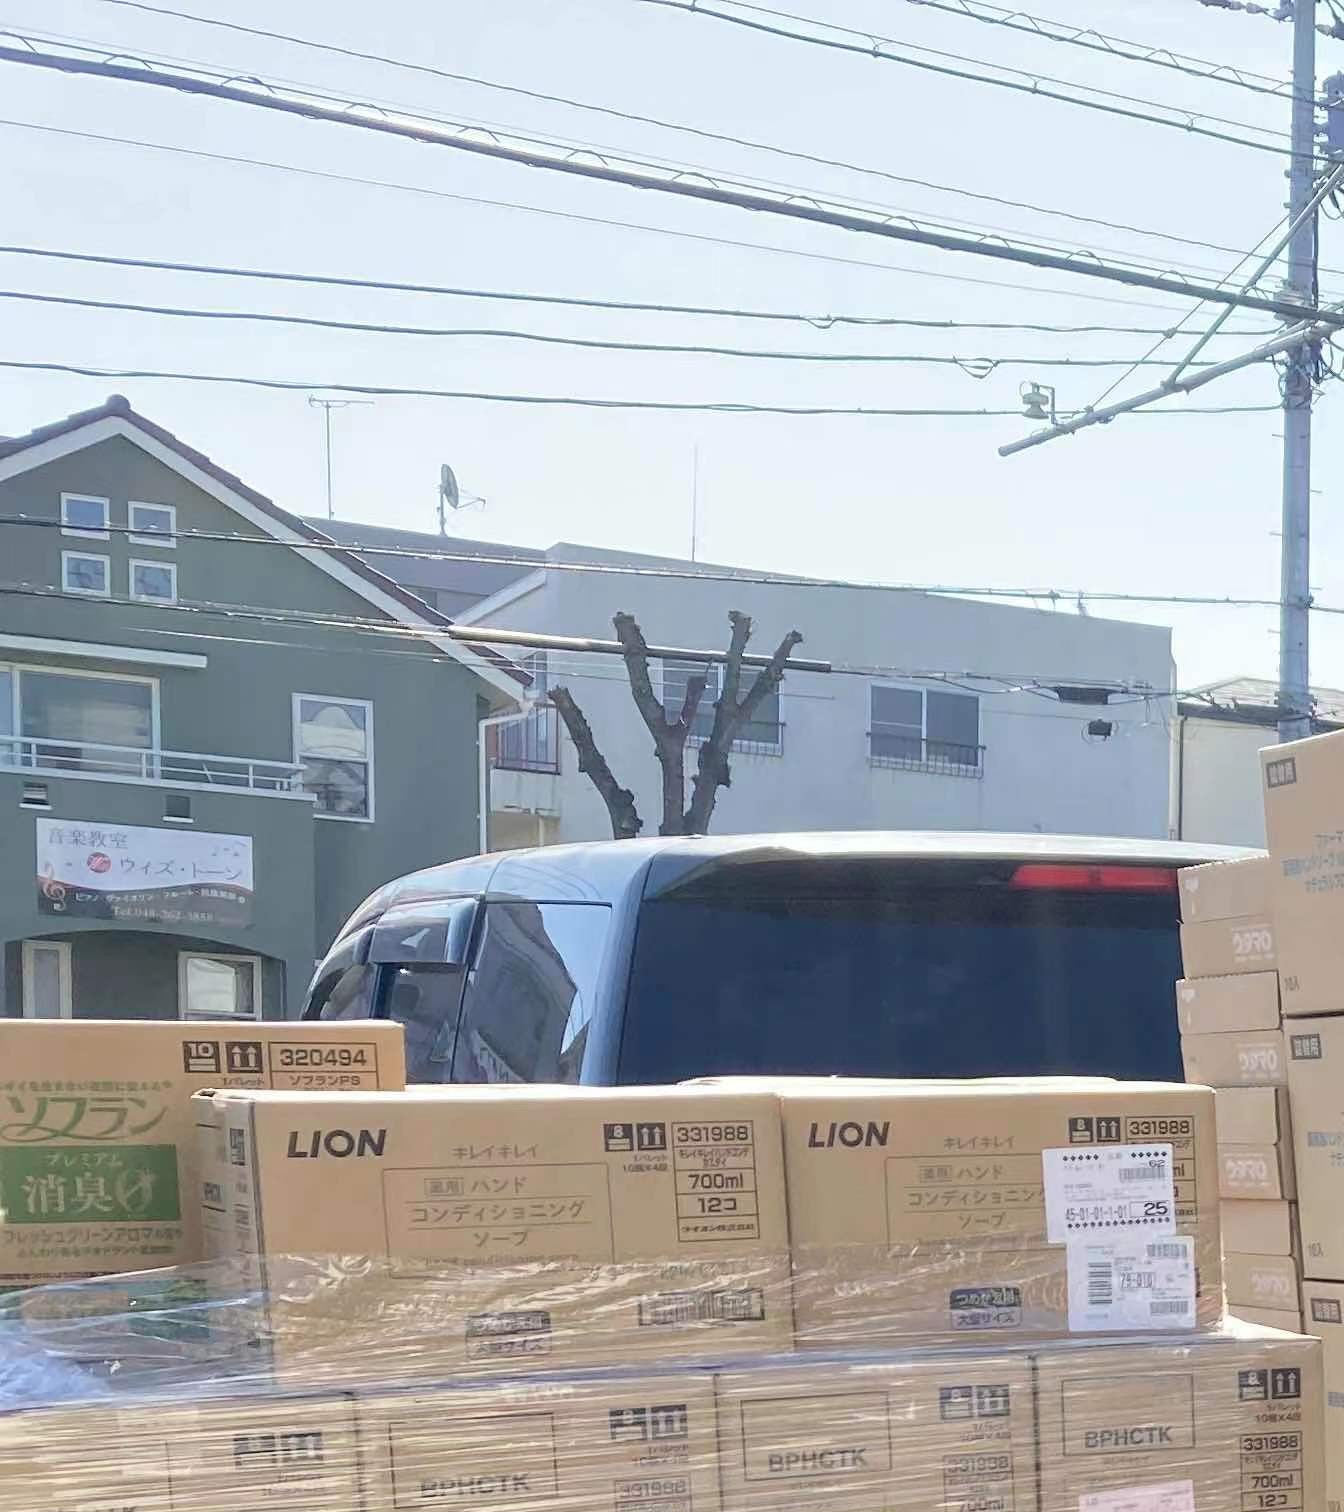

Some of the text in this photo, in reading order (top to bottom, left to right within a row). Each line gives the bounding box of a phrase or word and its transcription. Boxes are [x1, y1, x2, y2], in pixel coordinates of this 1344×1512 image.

[49, 827, 128, 849] 音楽教室
[279, 1047, 367, 1066] 320494
[676, 1125, 749, 1143] 331988
[807, 1121, 890, 1149] LION
[1129, 1118, 1191, 1136] 331988
[287, 1128, 387, 1158] LION
[471, 1175, 527, 1194] ハンド
[688, 1172, 745, 1190] 700ml
[24, 1171, 115, 1214] 消臭
[410, 1200, 585, 1225] コンディショニング
[1144, 1201, 1168, 1216] 25
[474, 1230, 529, 1247] ソープ
[1085, 1427, 1174, 1448] BPHCTK
